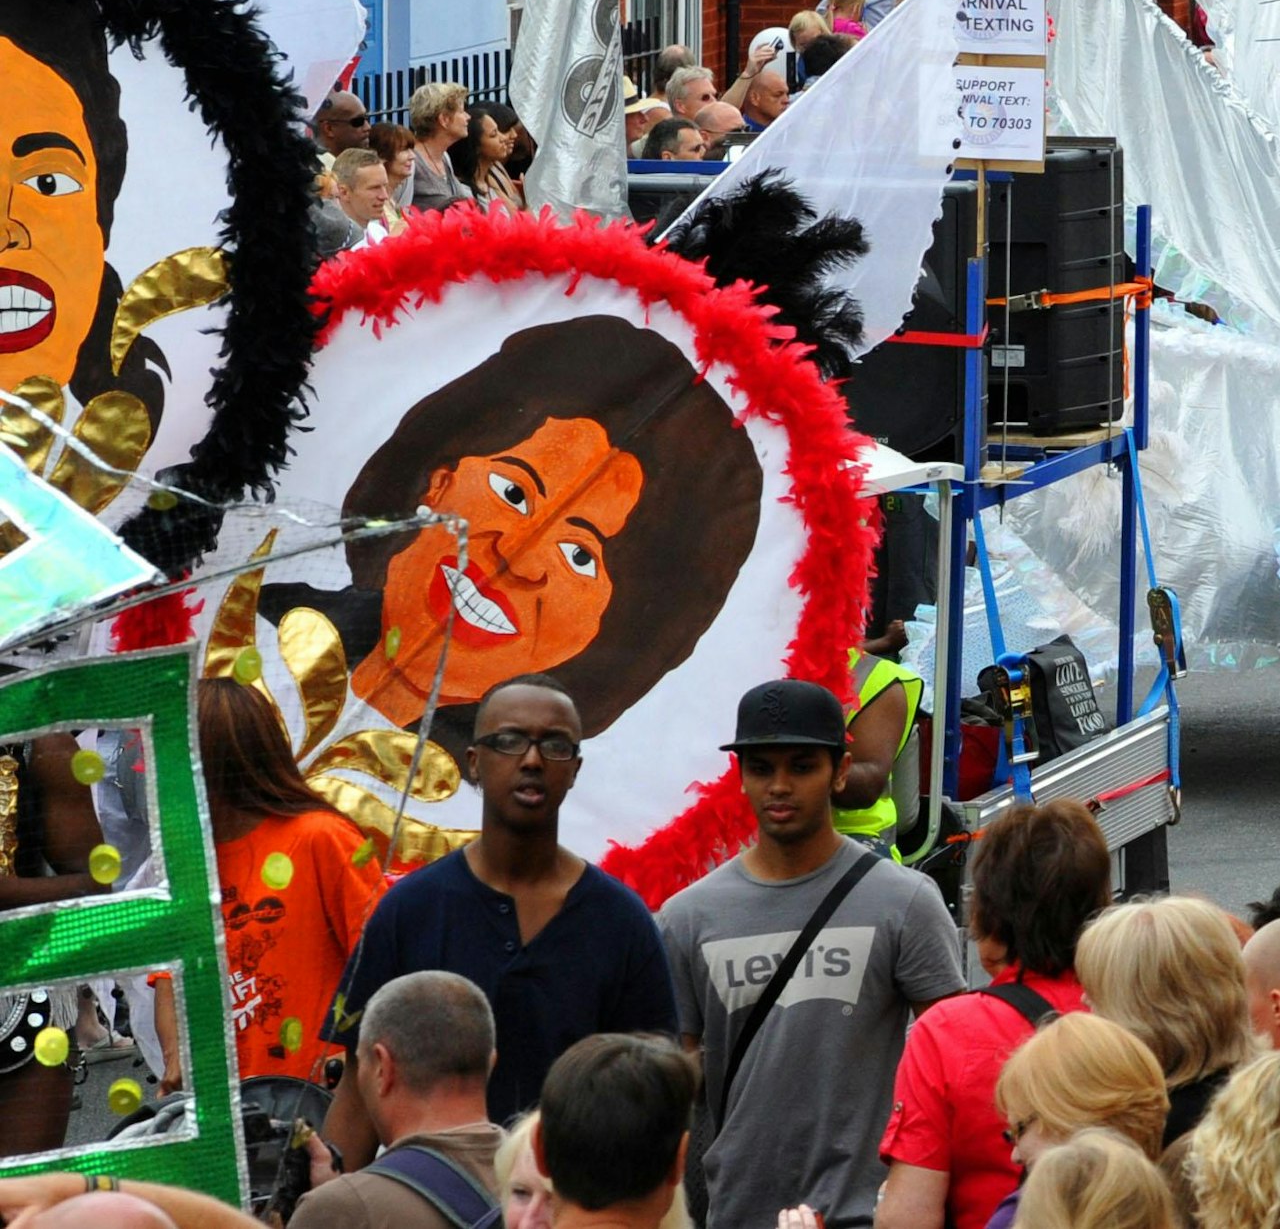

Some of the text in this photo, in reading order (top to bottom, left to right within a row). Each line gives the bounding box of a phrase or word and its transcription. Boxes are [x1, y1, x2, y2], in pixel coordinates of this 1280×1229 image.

[964, 18, 1034, 32] TEXTING
[998, 96, 1031, 107] TEXT:
[969, 116, 988, 128] TO
[992, 117, 1032, 130] 70303
